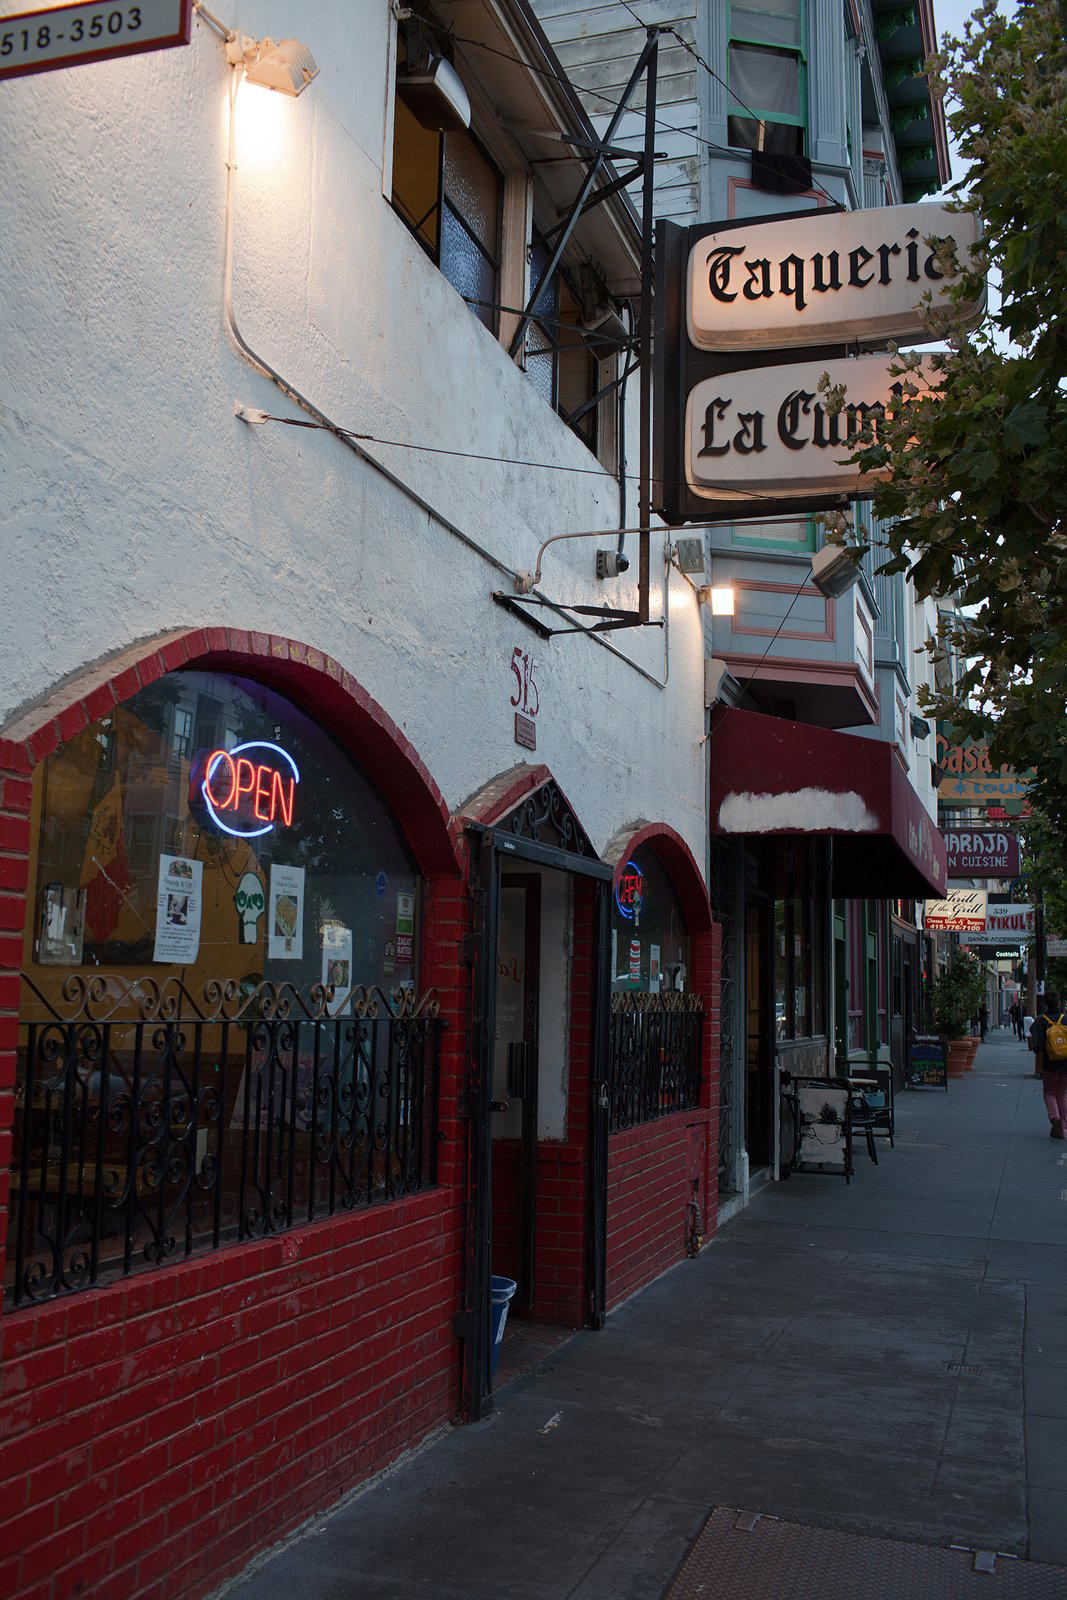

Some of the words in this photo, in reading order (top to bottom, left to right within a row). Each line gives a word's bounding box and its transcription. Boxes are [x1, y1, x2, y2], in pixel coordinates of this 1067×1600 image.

[1, 6, 142, 56] 518-3503
[697, 396, 767, 458] La
[777, 381, 941, 450] Cum
[205, 750, 295, 827] OPEN
[961, 856, 1009, 867] CUISINE
[928, 903, 939, 915] of
[949, 903, 983, 919] Grill
[993, 907, 1008, 915] 539
